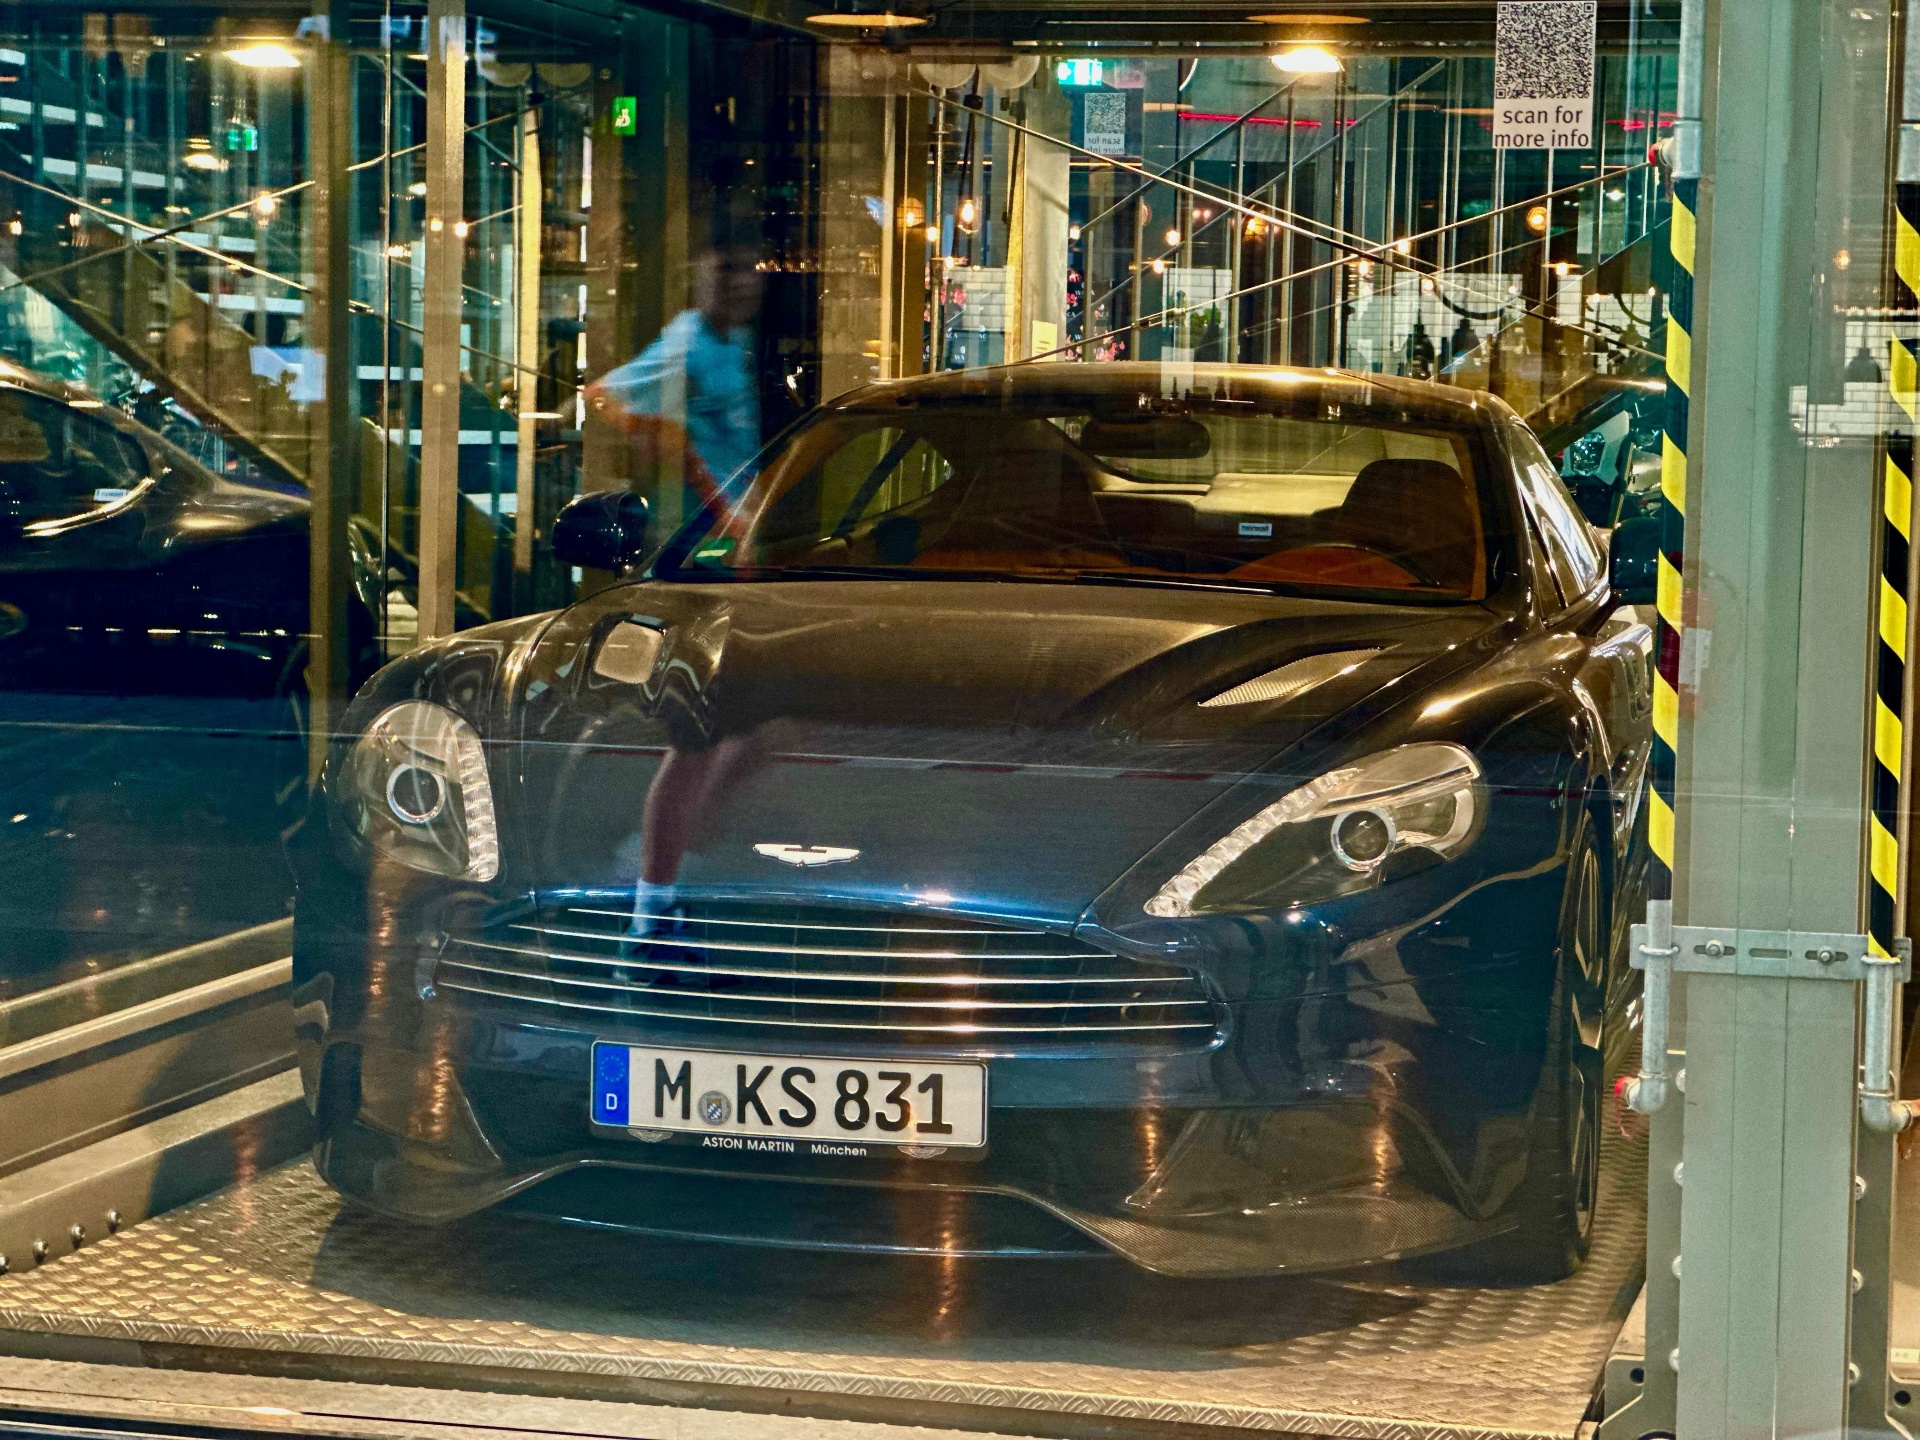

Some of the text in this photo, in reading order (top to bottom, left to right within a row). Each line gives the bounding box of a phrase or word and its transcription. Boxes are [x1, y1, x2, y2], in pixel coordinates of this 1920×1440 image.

[1503, 105, 1583, 124] scan for
[1494, 129, 1589, 147] more info
[606, 1093, 618, 1110] D
[655, 1058, 692, 1120] M
[737, 1064, 816, 1128] KS
[834, 1069, 953, 1135] 831
[702, 1136, 867, 1157] ASTON MARTIN München
